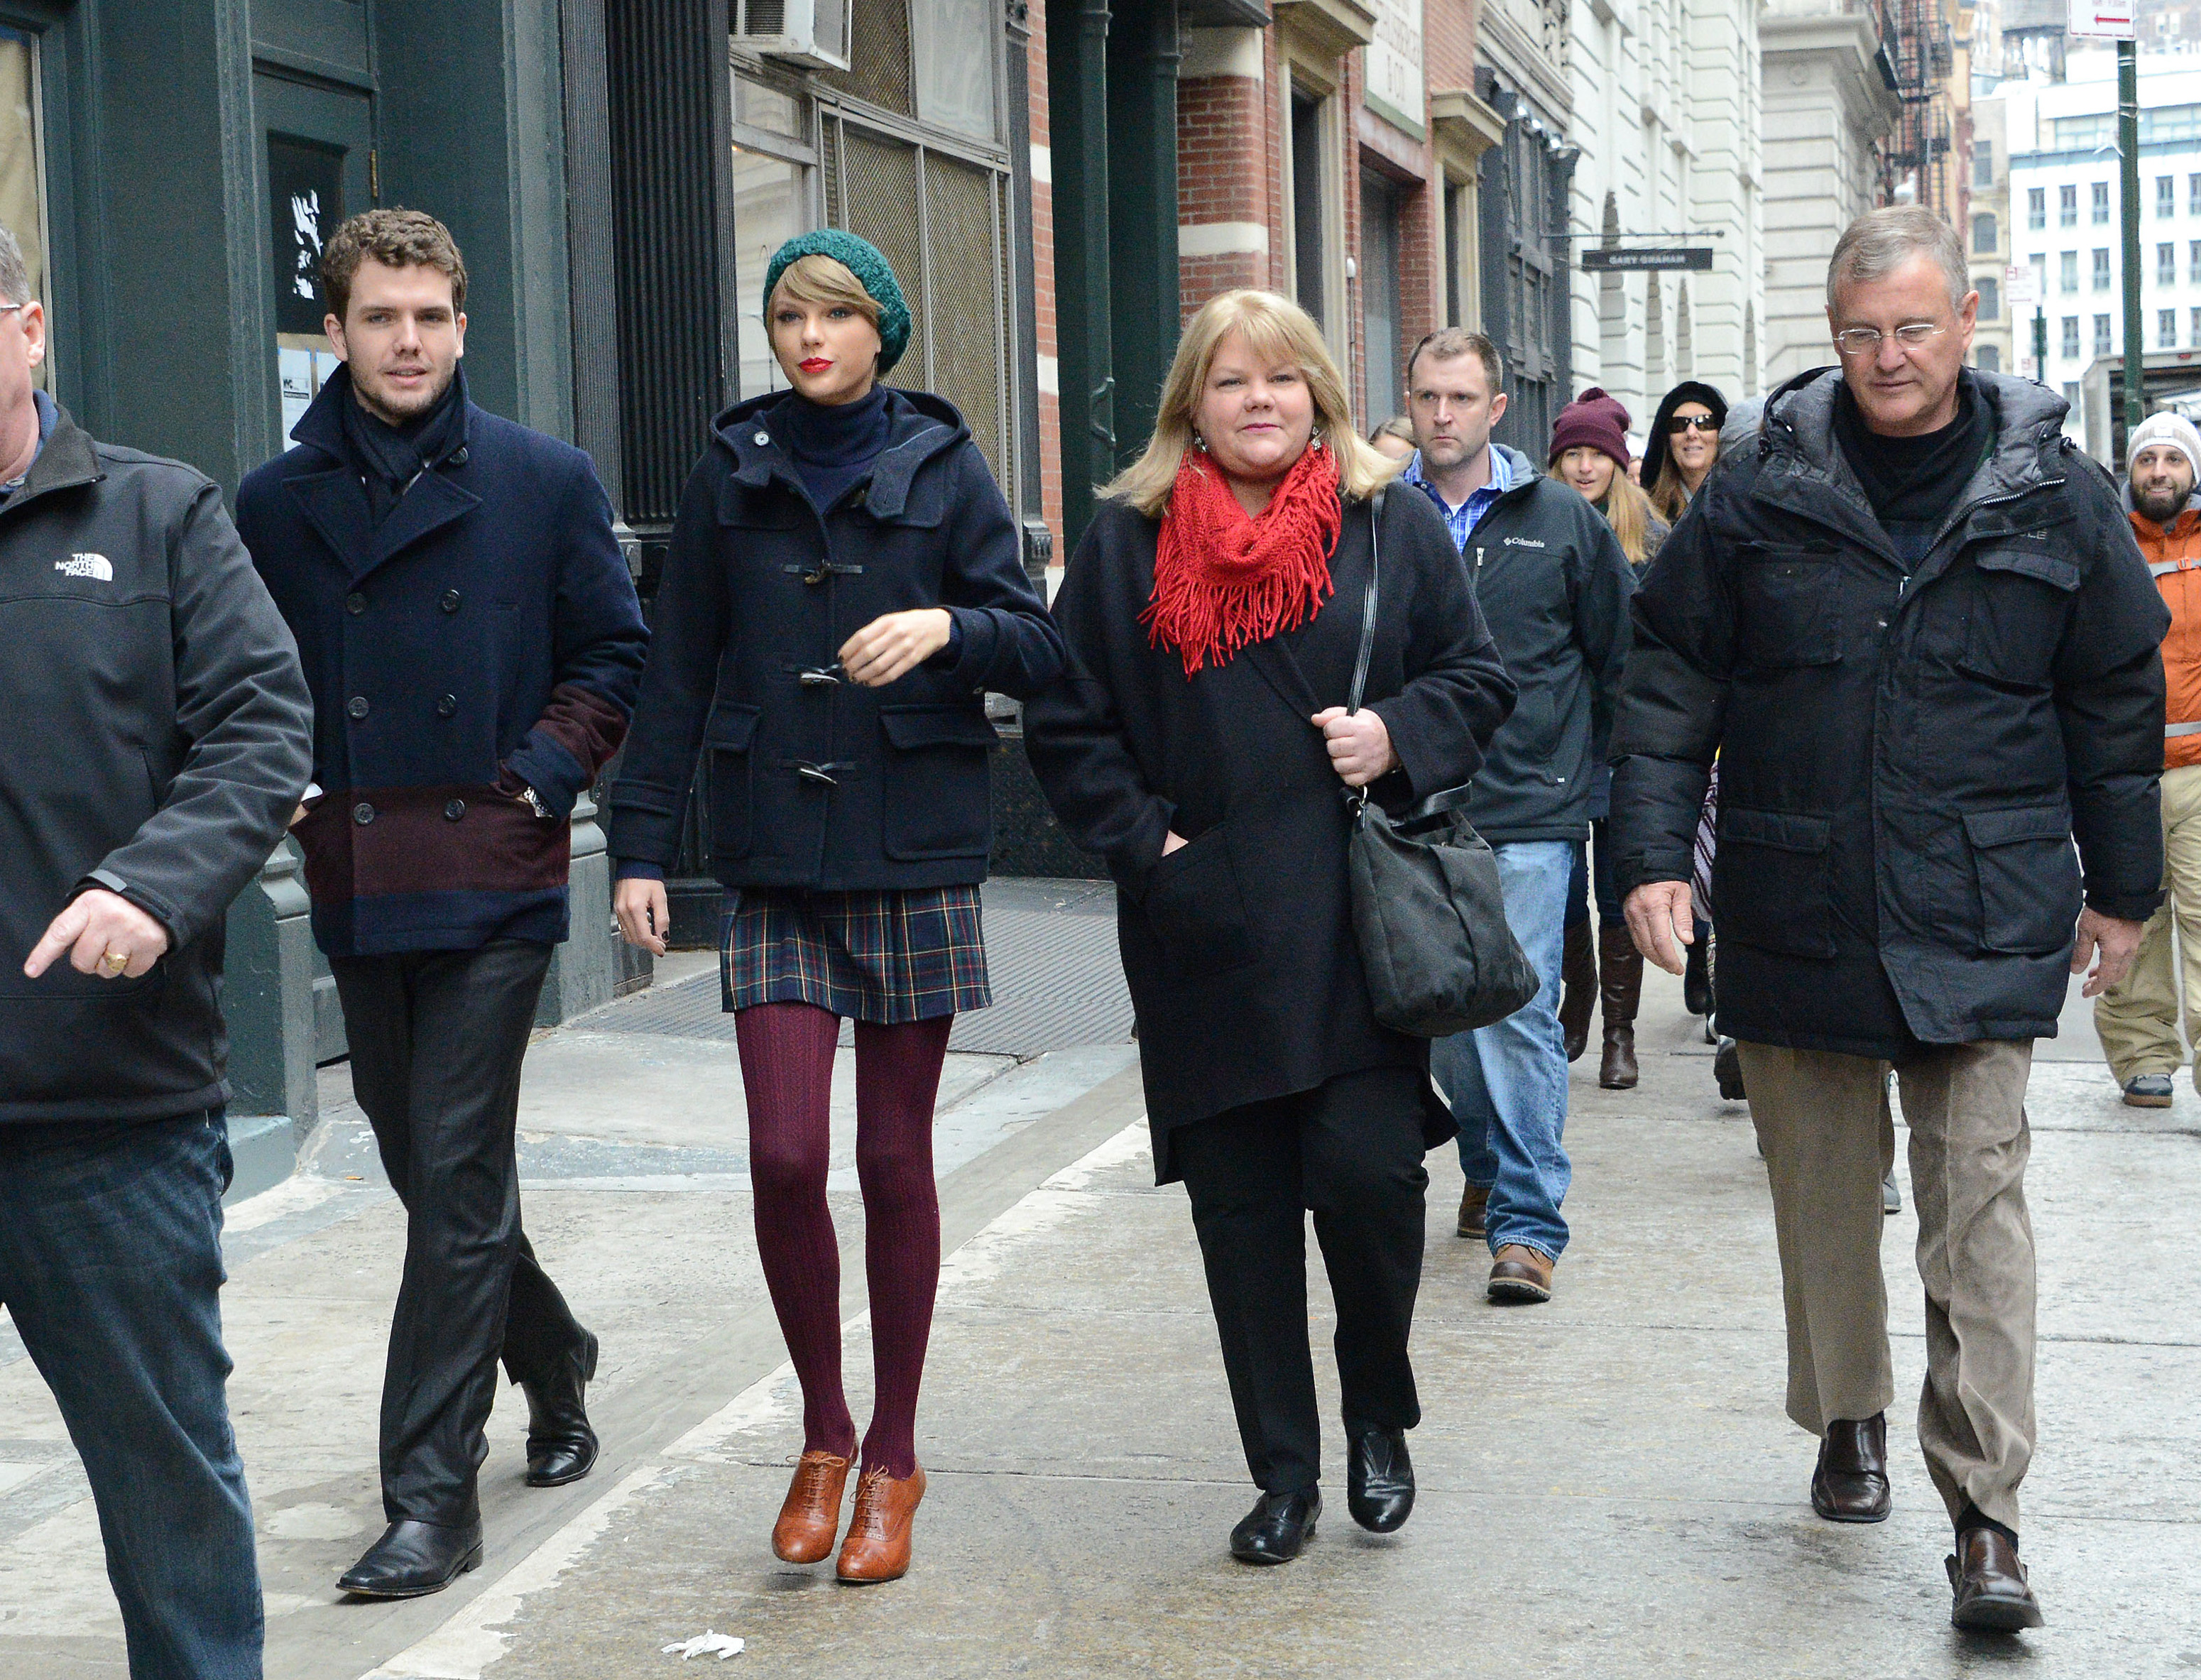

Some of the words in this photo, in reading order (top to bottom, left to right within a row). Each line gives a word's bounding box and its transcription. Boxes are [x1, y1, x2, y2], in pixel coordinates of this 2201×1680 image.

[1512, 537, 1545, 548] Columbia
[72, 553, 94, 562] THE
[55, 560, 94, 570] NORTH
[65, 568, 94, 577] FACE
